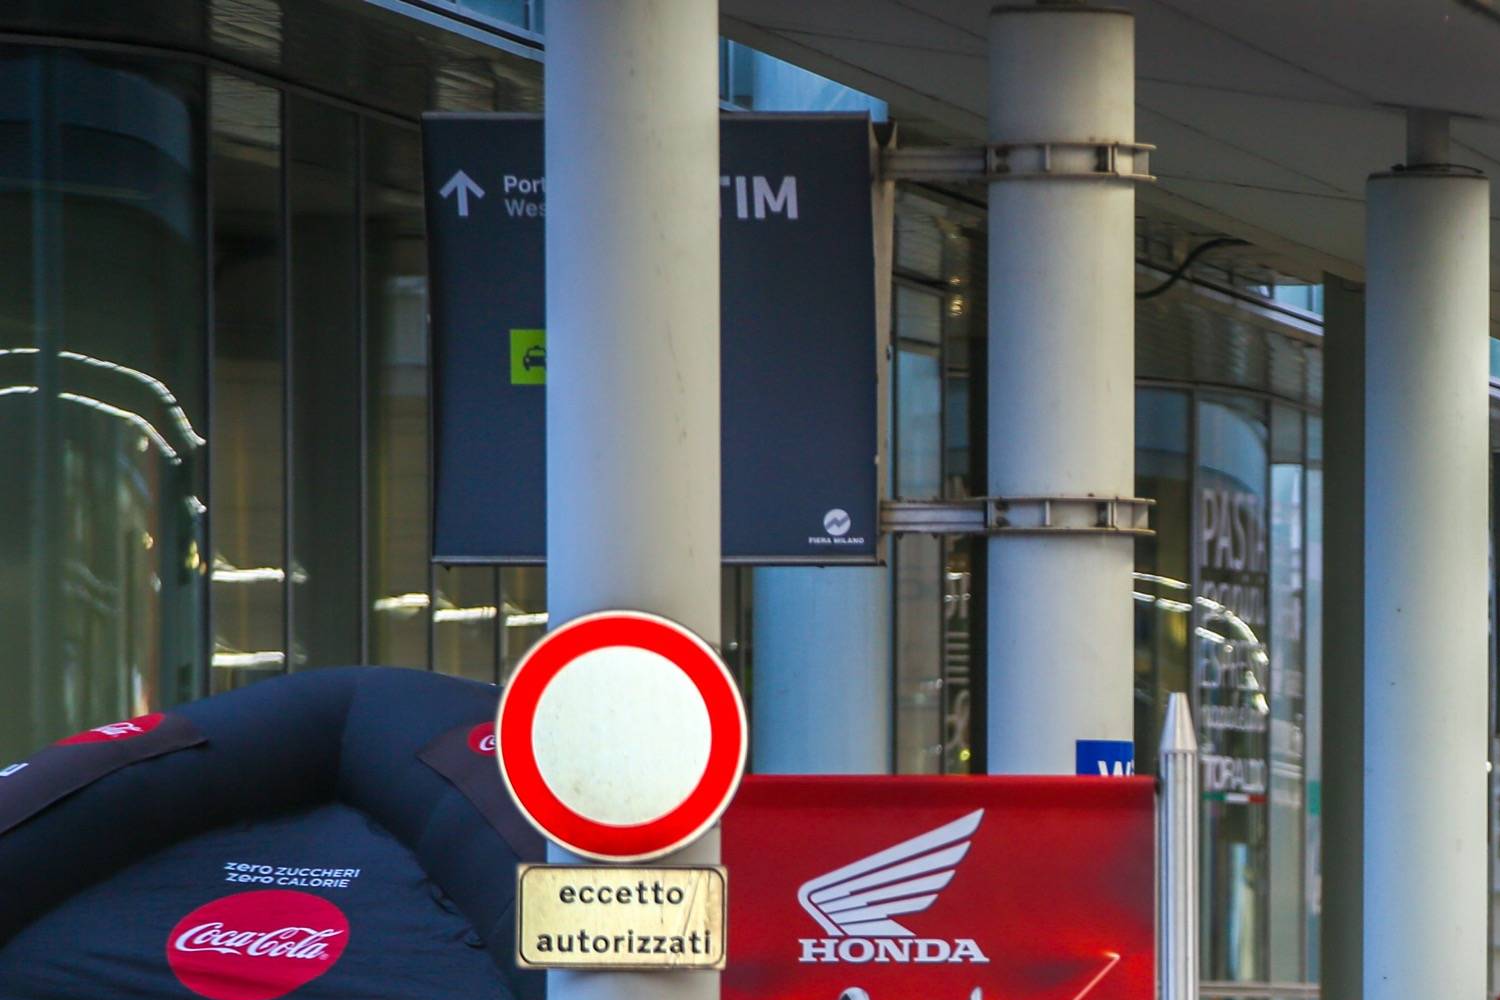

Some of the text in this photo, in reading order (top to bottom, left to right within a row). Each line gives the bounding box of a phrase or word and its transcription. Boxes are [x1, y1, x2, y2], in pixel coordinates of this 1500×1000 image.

[224, 862, 361, 878] zero ZUCCHERI
[225, 872, 351, 888] zero CALORIE
[559, 880, 685, 905] eccetto
[175, 922, 345, 960] Coca-Cola
[536, 929, 712, 954] autorizzati
[798, 938, 991, 963] HONDA
